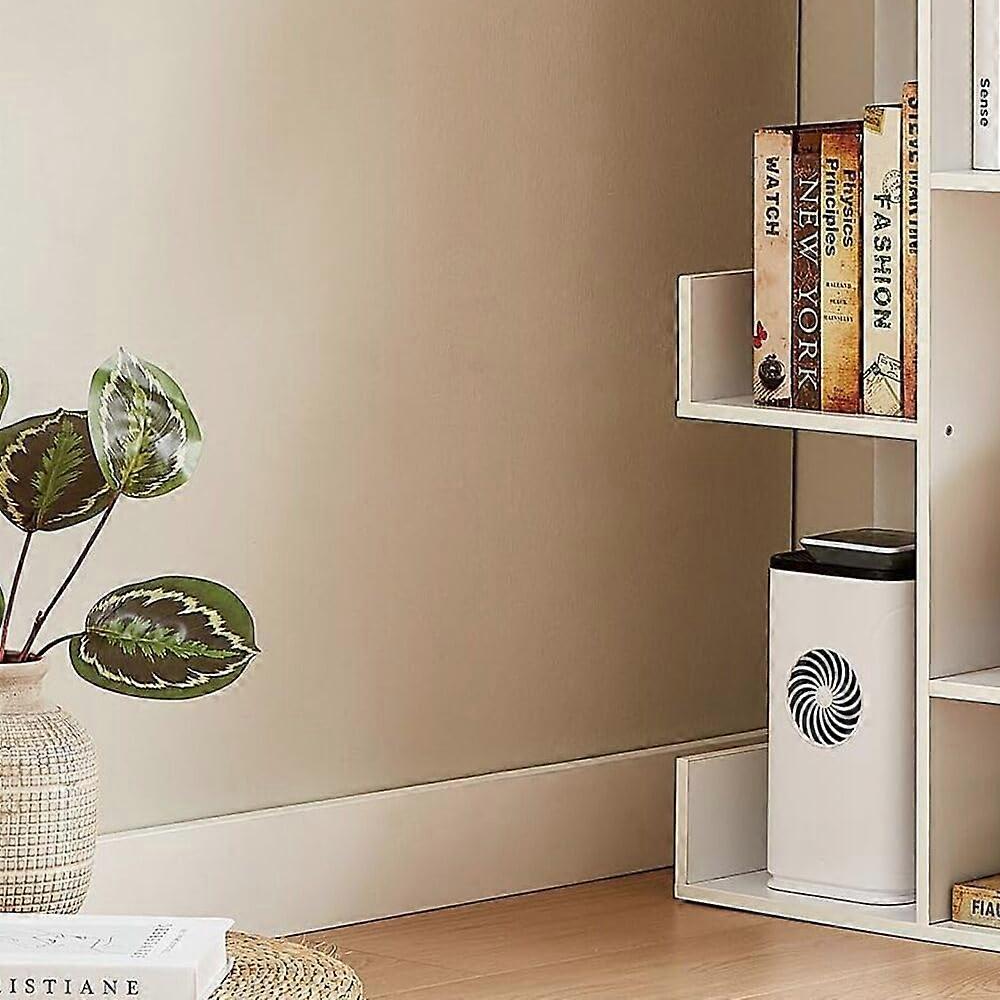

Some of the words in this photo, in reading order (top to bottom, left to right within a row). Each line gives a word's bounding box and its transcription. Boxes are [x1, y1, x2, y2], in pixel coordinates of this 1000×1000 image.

[980, 78, 991, 127] Sense
[766, 155, 780, 237] WATCH
[798, 171, 820, 267] NEW
[822, 157, 839, 258] Principles
[839, 169, 858, 248] Physics
[873, 193, 892, 329] FASHION
[798, 285, 820, 391] YORK
[0, 978, 140, 996] ISTIANE
